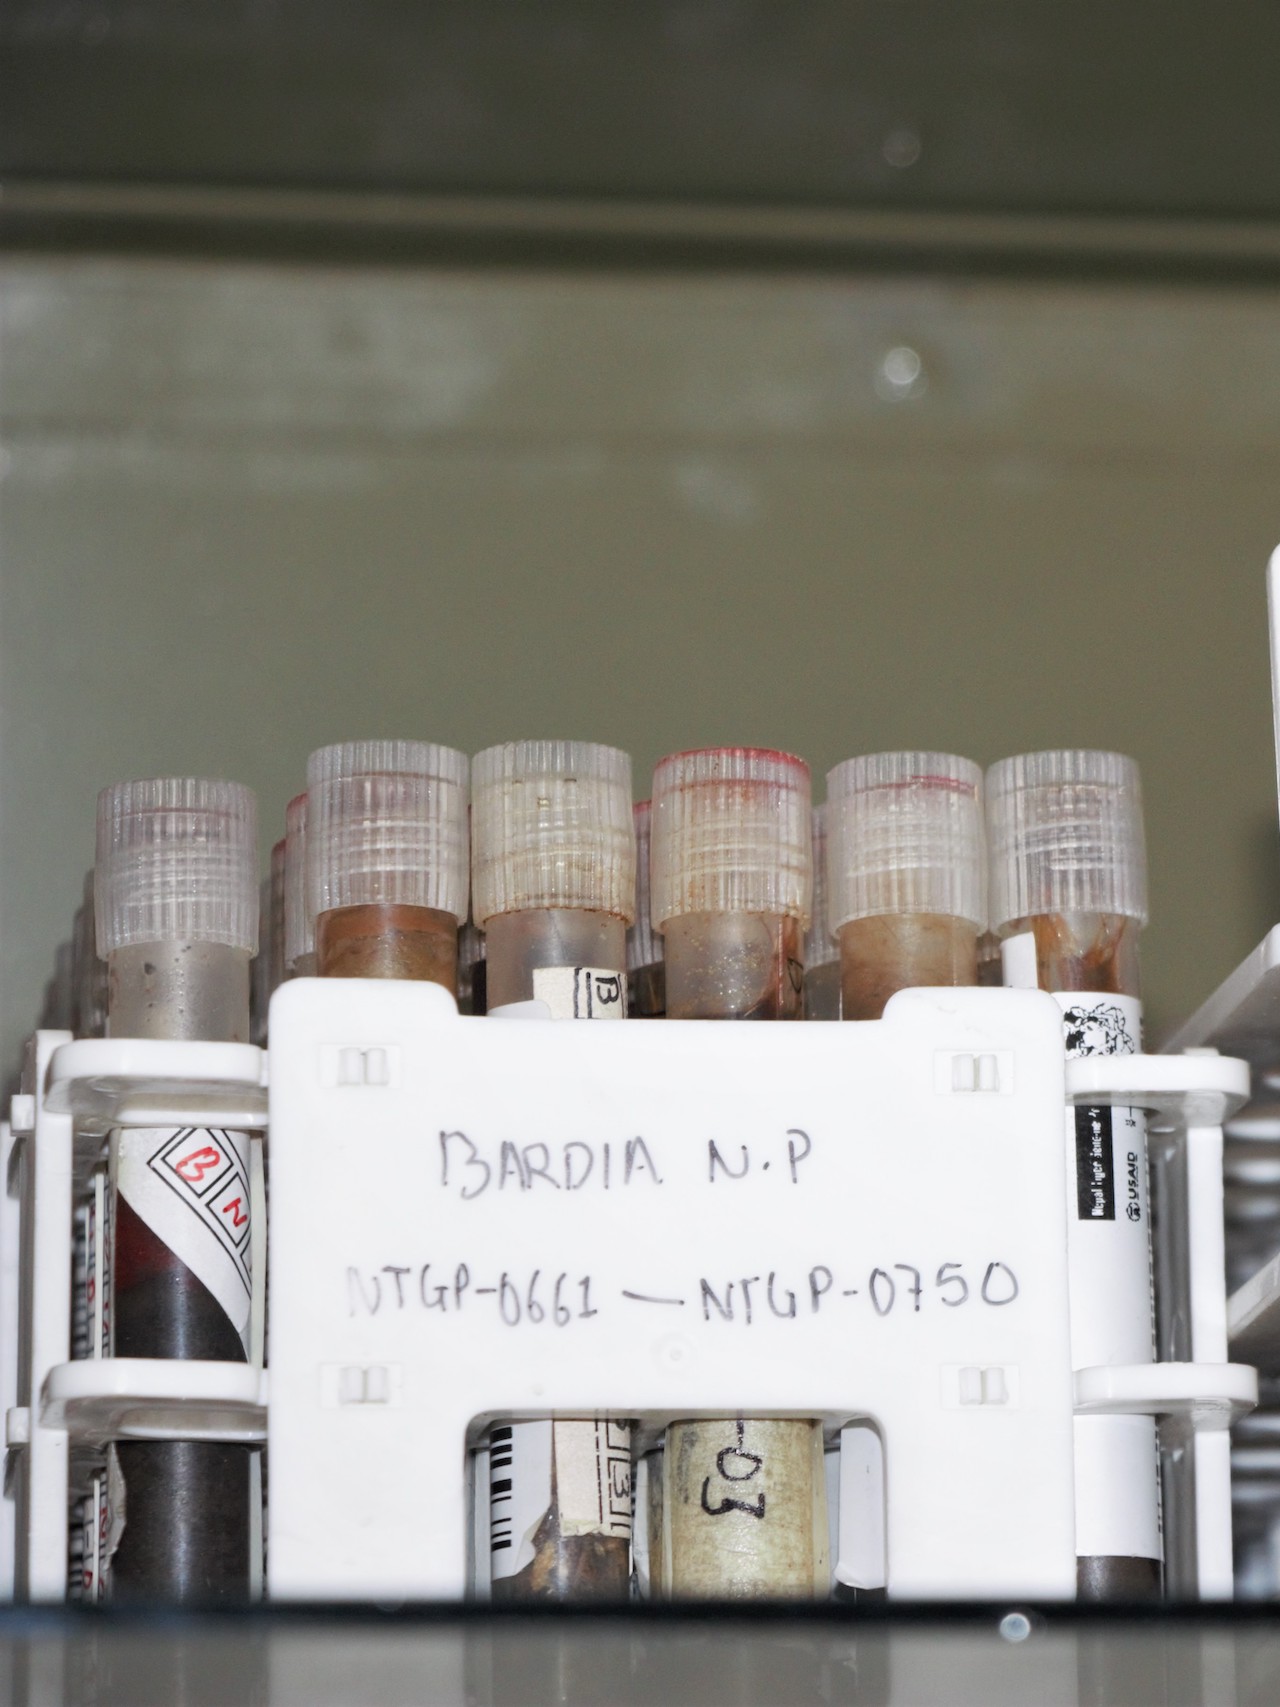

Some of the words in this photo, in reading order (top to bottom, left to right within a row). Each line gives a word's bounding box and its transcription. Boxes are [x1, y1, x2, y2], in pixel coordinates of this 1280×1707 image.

[438, 1130, 664, 1200] BARDIA
[707, 1128, 812, 1185] N.P
[1126, 1151, 1138, 1200] USAID
